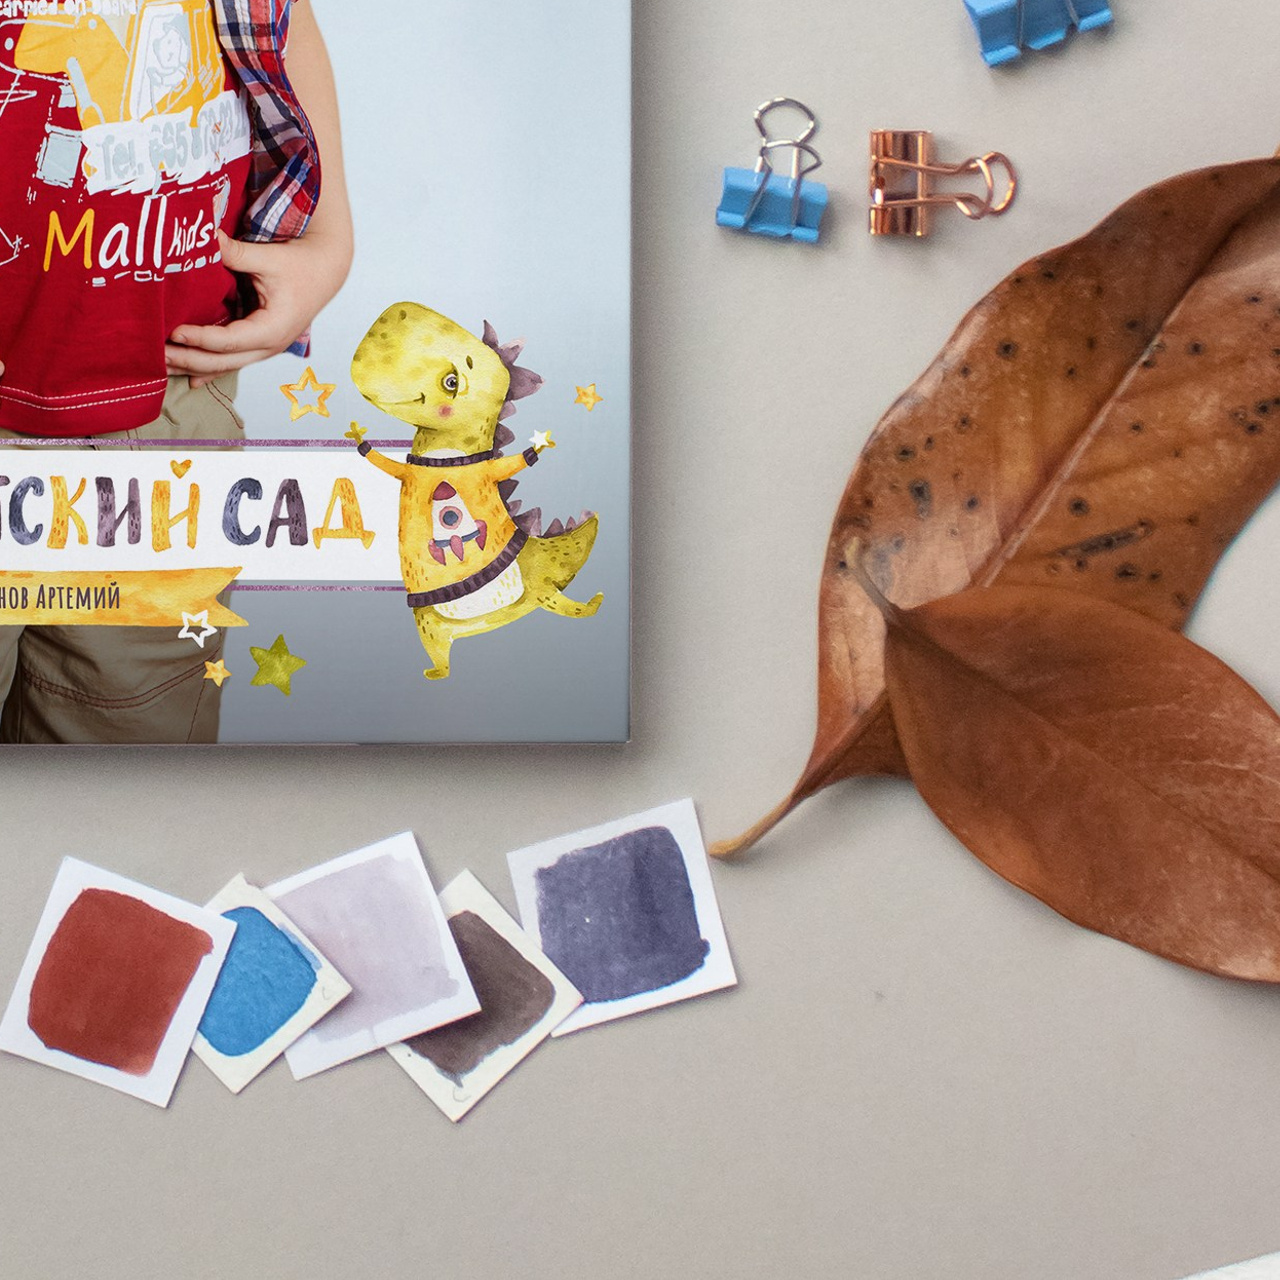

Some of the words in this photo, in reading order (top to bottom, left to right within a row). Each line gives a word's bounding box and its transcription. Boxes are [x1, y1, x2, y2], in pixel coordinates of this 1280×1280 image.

[43, 195, 167, 273] Mall
[221, 477, 376, 550] САД
[35, 581, 120, 610] Артемий
